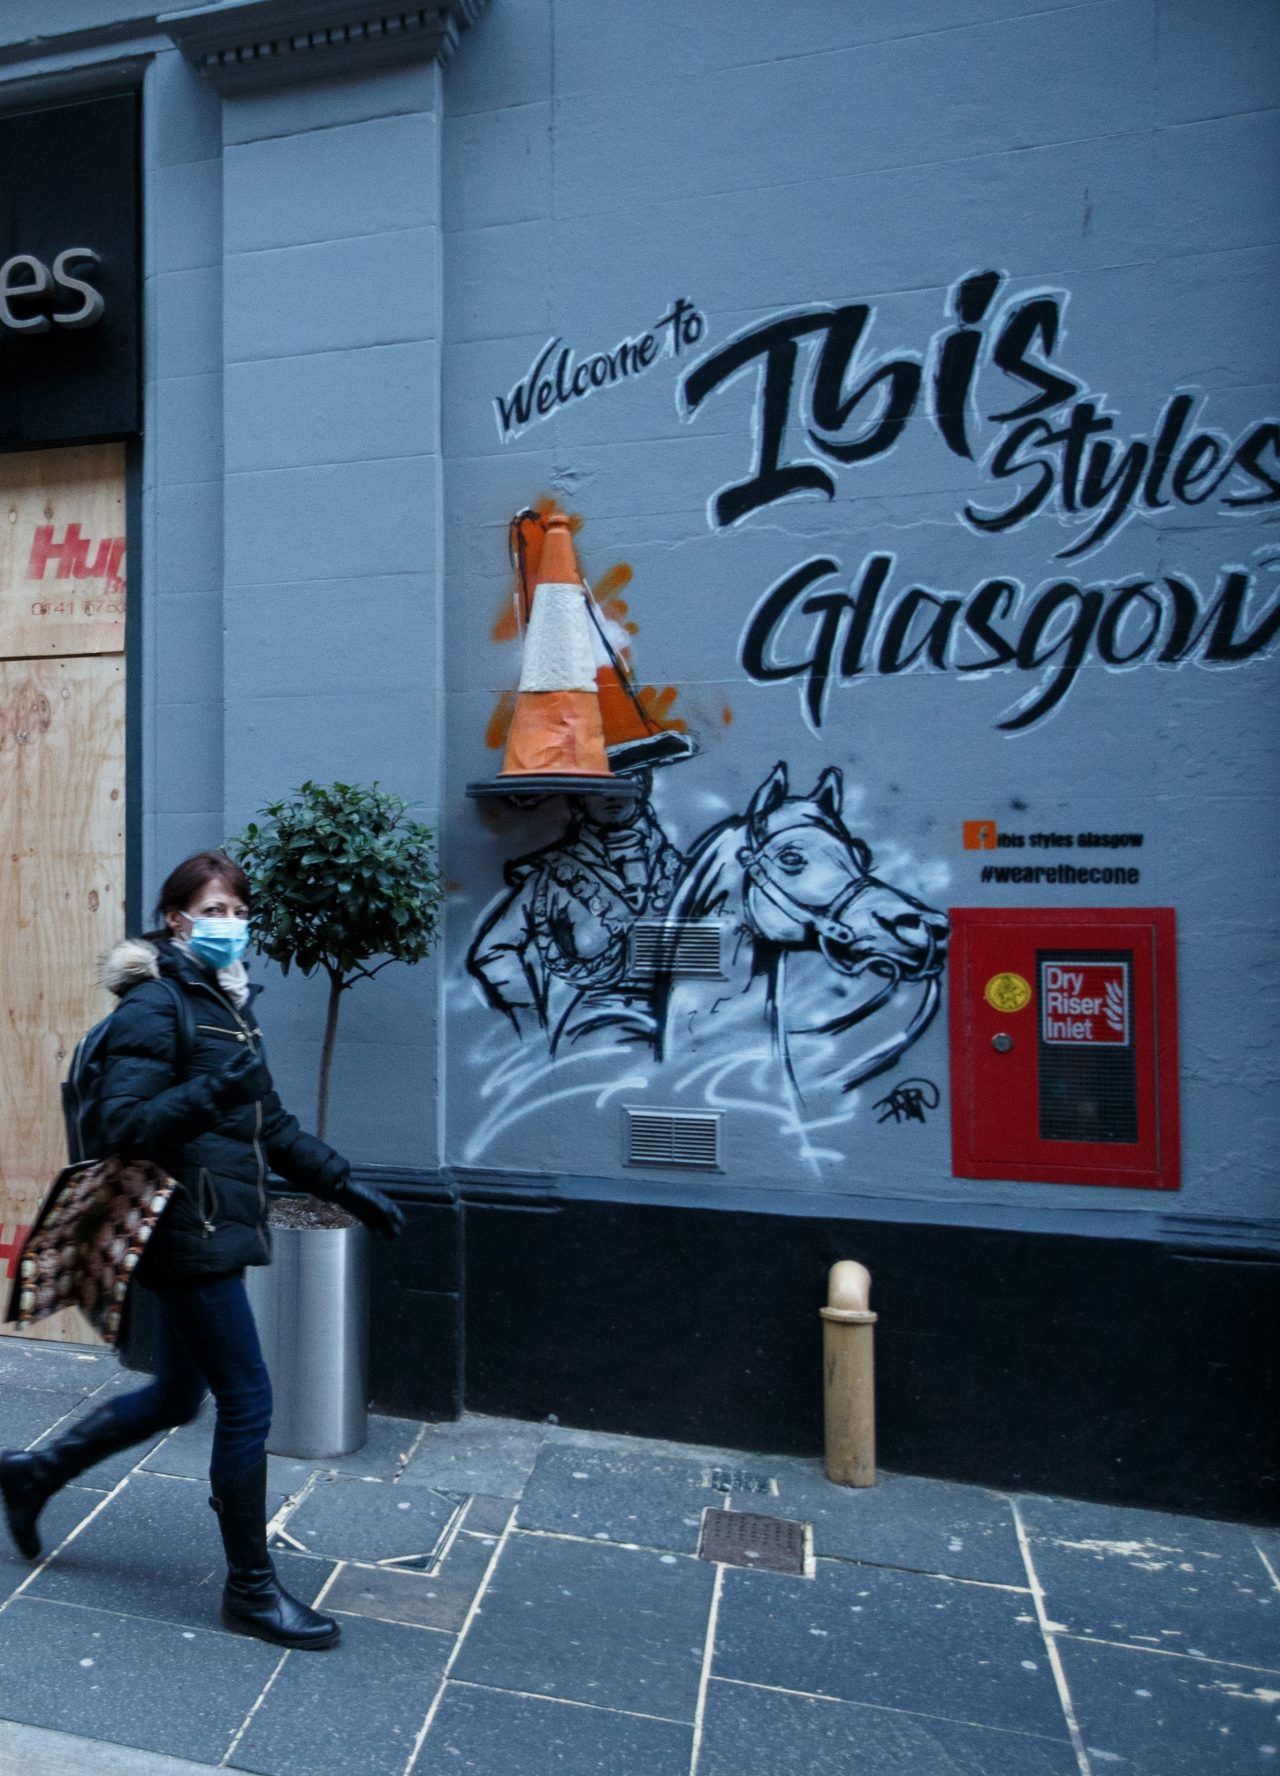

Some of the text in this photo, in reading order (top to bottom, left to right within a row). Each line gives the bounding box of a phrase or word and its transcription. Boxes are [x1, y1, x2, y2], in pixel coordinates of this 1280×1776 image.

[494, 297, 704, 435] Welcome to
[684, 270, 1081, 530] Ibis
[963, 394, 1280, 559] Styles
[26, 523, 126, 580] Hur
[103, 577, 126, 595] Br
[742, 555, 1280, 731] Glasgow
[981, 865, 1140, 885] #wearethecone
[1047, 967, 1083, 995] Dry
[1047, 992, 1103, 1014] Riser
[1047, 1017, 1092, 1039] Inlet
